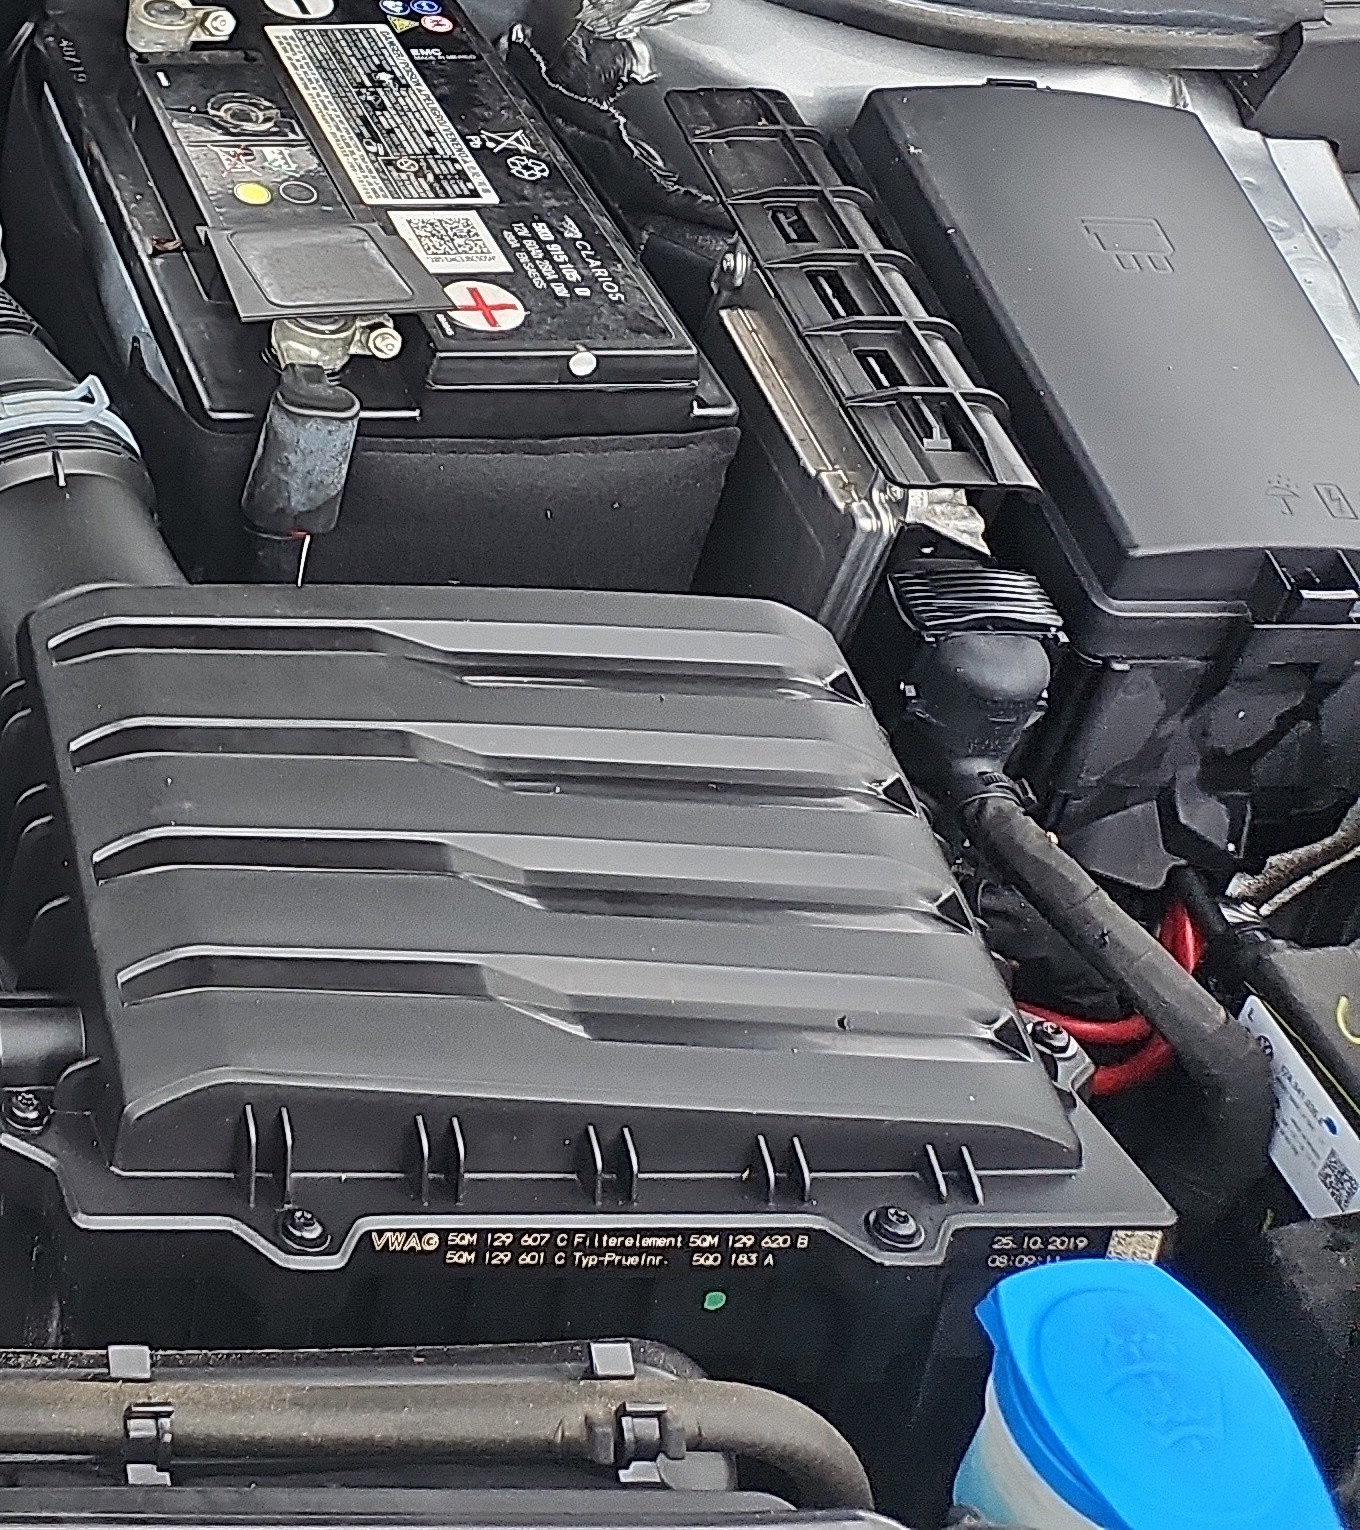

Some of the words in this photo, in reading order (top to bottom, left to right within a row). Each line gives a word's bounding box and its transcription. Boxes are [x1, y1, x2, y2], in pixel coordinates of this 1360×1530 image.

[574, 236, 625, 303] CLARIOS
[447, 1232, 477, 1245] 5QM
[486, 1232, 513, 1246] 129
[520, 1232, 550, 1245] 607
[556, 1233, 567, 1246] C
[573, 1233, 682, 1247] Filterelement
[688, 1235, 719, 1247] 5QM
[728, 1235, 754, 1247] 129
[761, 1235, 790, 1247] 620
[796, 1235, 808, 1247] B
[991, 1236, 1088, 1250] 25.10.2019
[445, 1251, 475, 1263] 5QM
[484, 1251, 511, 1264] 129
[518, 1252, 544, 1264] 601
[554, 1252, 565, 1264] C
[730, 1253, 757, 1265] 183
[763, 1254, 773, 1265] A
